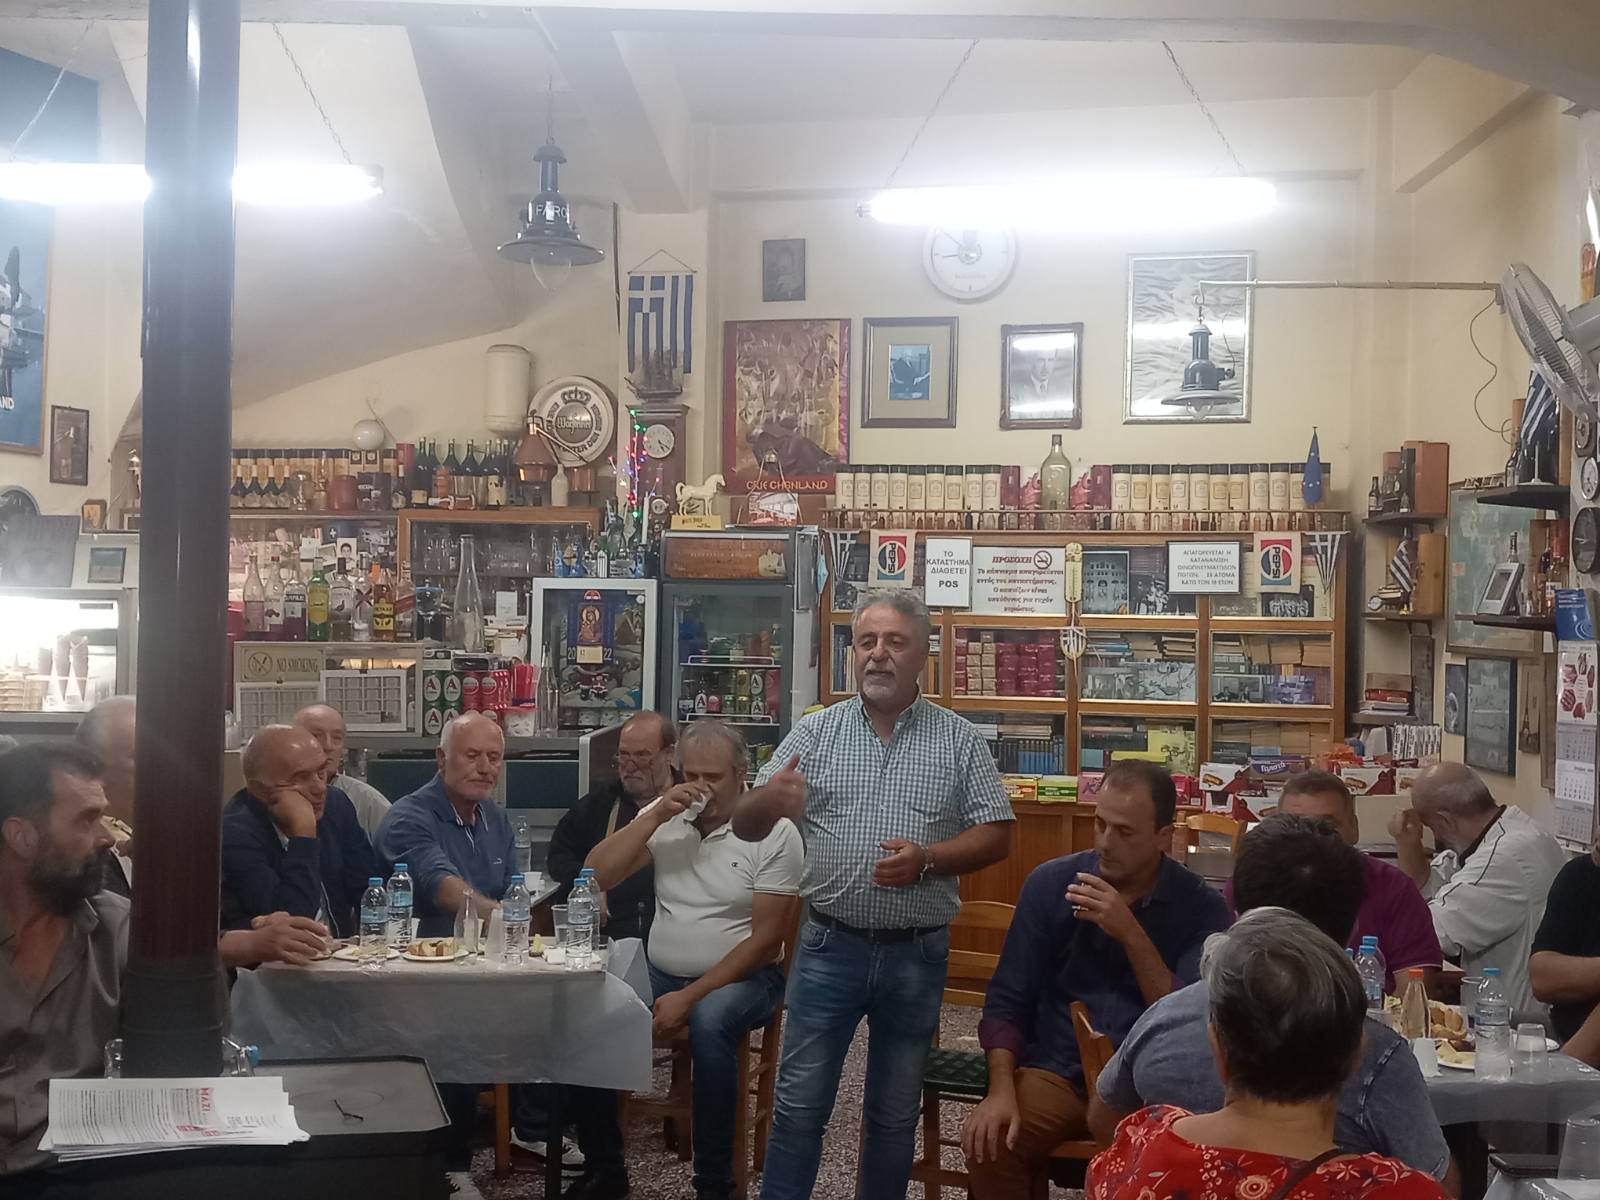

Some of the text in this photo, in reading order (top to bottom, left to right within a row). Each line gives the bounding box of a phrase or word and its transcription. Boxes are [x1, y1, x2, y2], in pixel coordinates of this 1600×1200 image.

[888, 542, 896, 574] PEPSI
[992, 556, 1032, 564] ΠΡΟΣΟΧΗ
[1272, 546, 1280, 578] PEPSI
[938, 580, 958, 588] POS
[276, 657, 318, 672] NO SMOKING
